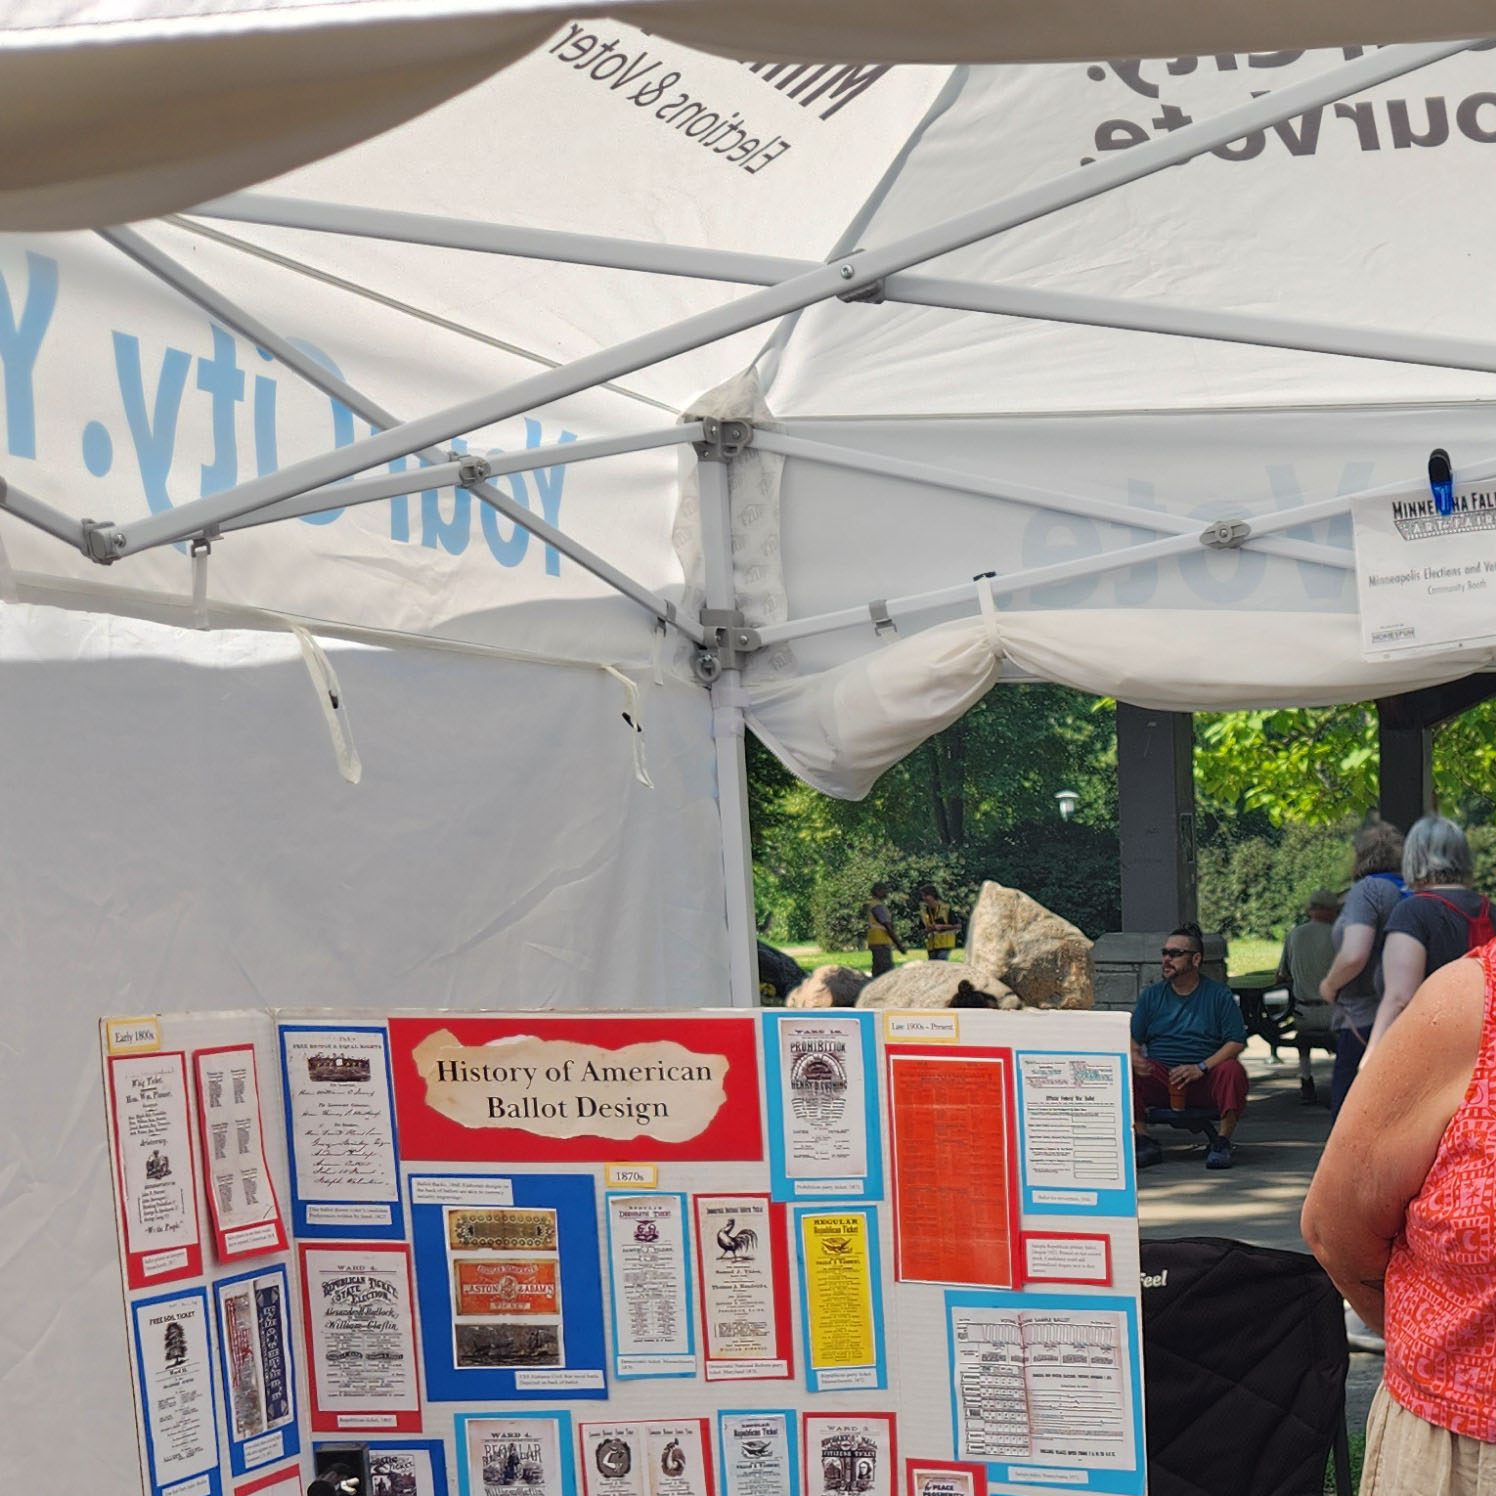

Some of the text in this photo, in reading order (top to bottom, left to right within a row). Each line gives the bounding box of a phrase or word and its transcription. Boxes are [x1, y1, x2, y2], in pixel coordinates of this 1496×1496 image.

[1392, 494, 1468, 520] MINNEHA
[1368, 570, 1421, 587] Minneapolis
[1423, 565, 1461, 580] Elections
[1464, 561, 1481, 575] and
[930, 1022, 954, 1031] Present
[115, 1029, 134, 1043] Early
[790, 1040, 846, 1053] PROHIBITION
[436, 1059, 713, 1089] History of American
[486, 1096, 669, 1126] Ballot Design
[615, 1171, 645, 1182] 1870s
[813, 1225, 859, 1234] Republican Ticket
[149, 1316, 163, 1326] FREE
[176, 1310, 195, 1321] TICKET
[733, 1428, 778, 1438] Republican Ticket
[484, 1443, 542, 1462] REGLAR
